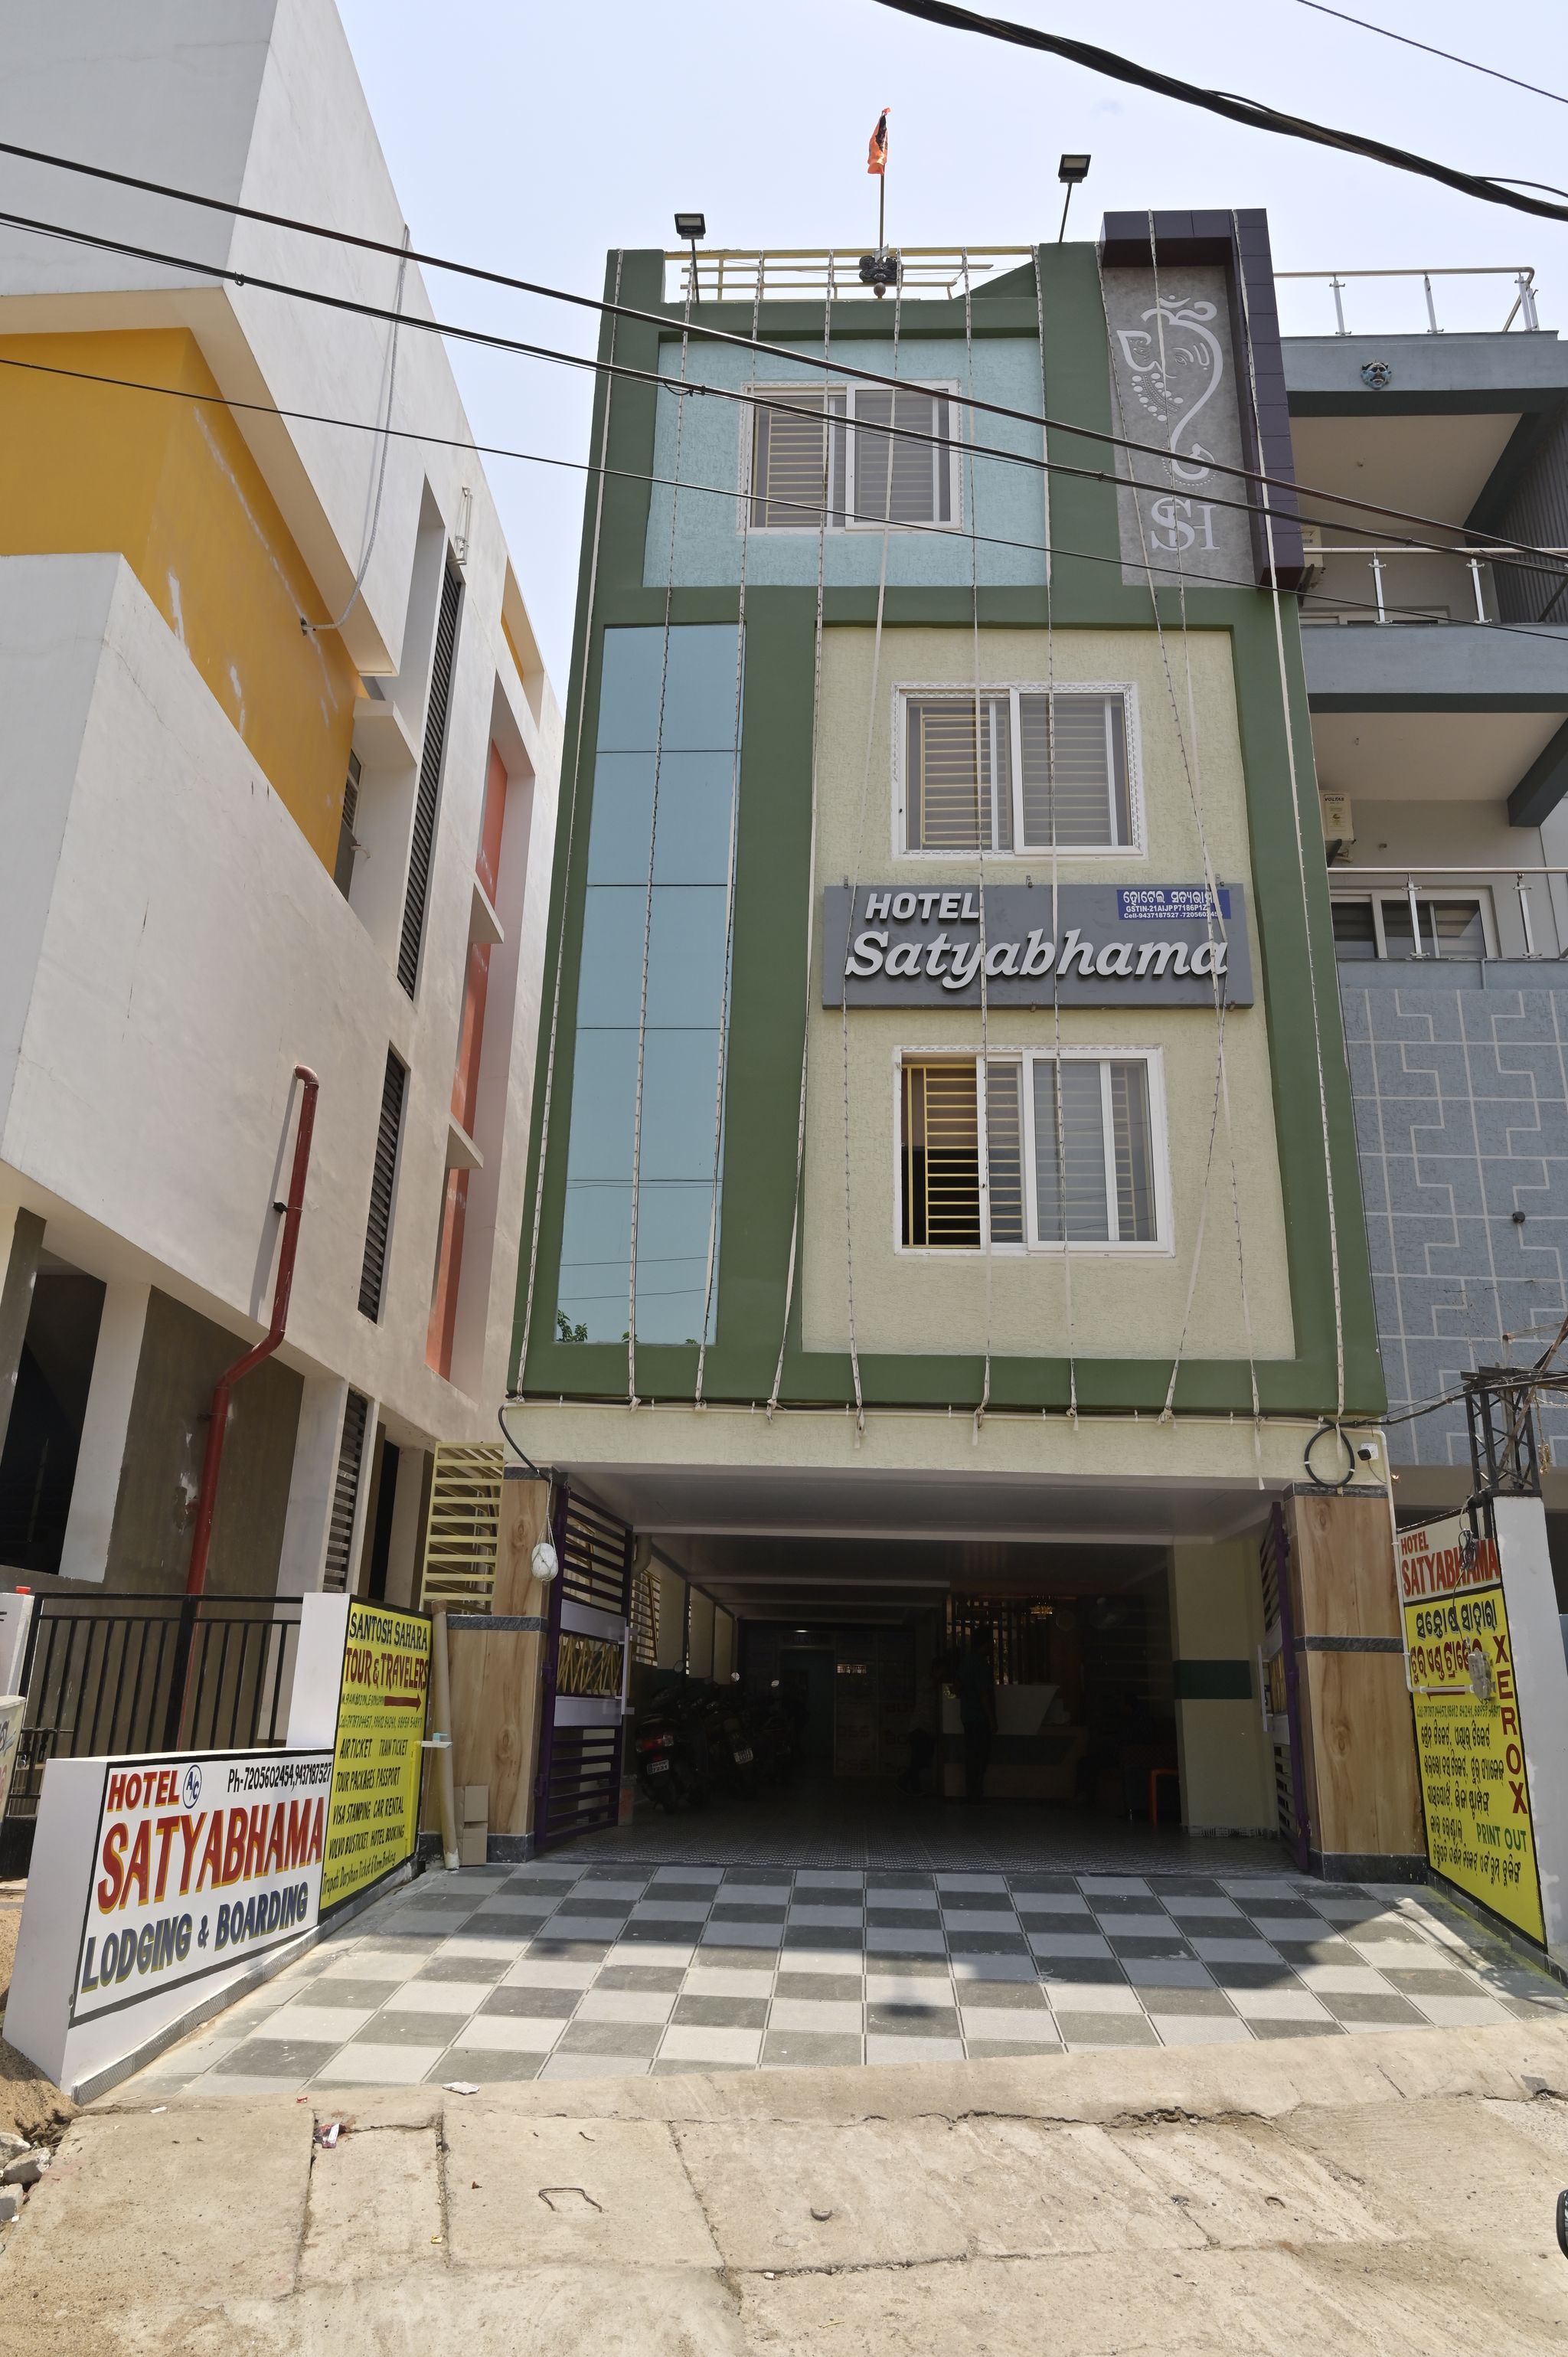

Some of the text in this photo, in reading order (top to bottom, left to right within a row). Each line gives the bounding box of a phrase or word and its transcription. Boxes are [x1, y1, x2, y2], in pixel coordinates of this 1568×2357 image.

[864, 892, 981, 920] HOTEL
[1123, 891, 1165, 905] ହୋଟେଲ
[844, 928, 1229, 989] Satyabhama
[1401, 1531, 1429, 1556] HOTEL
[1401, 1538, 1502, 1597] SATYABHAMA
[349, 1611, 428, 1652] SANTOSH SAHARA
[345, 1647, 429, 1693] TOUR & TRAVELERS
[1492, 1634, 1528, 1815] XEROX
[339, 1739, 349, 1760] AIR
[379, 1739, 392, 1757] TRAIN
[392, 1739, 408, 1757] TICKET
[107, 1770, 180, 1814] HOTEL
[335, 1770, 349, 1793] TOUR
[375, 1766, 400, 1789] PASSPORT
[332, 1803, 345, 1826] VISA
[384, 1796, 403, 1816] RENTAL
[97, 1796, 325, 1915] SATYABHAMA
[328, 1836, 345, 1861] VOLVO
[371, 1828, 385, 1847] HOTEL
[385, 1824, 405, 1843] BOOKING
[1476, 1823, 1527, 1852] PRINT OUT
[80, 1881, 309, 1994] LODGING & BOARDING
